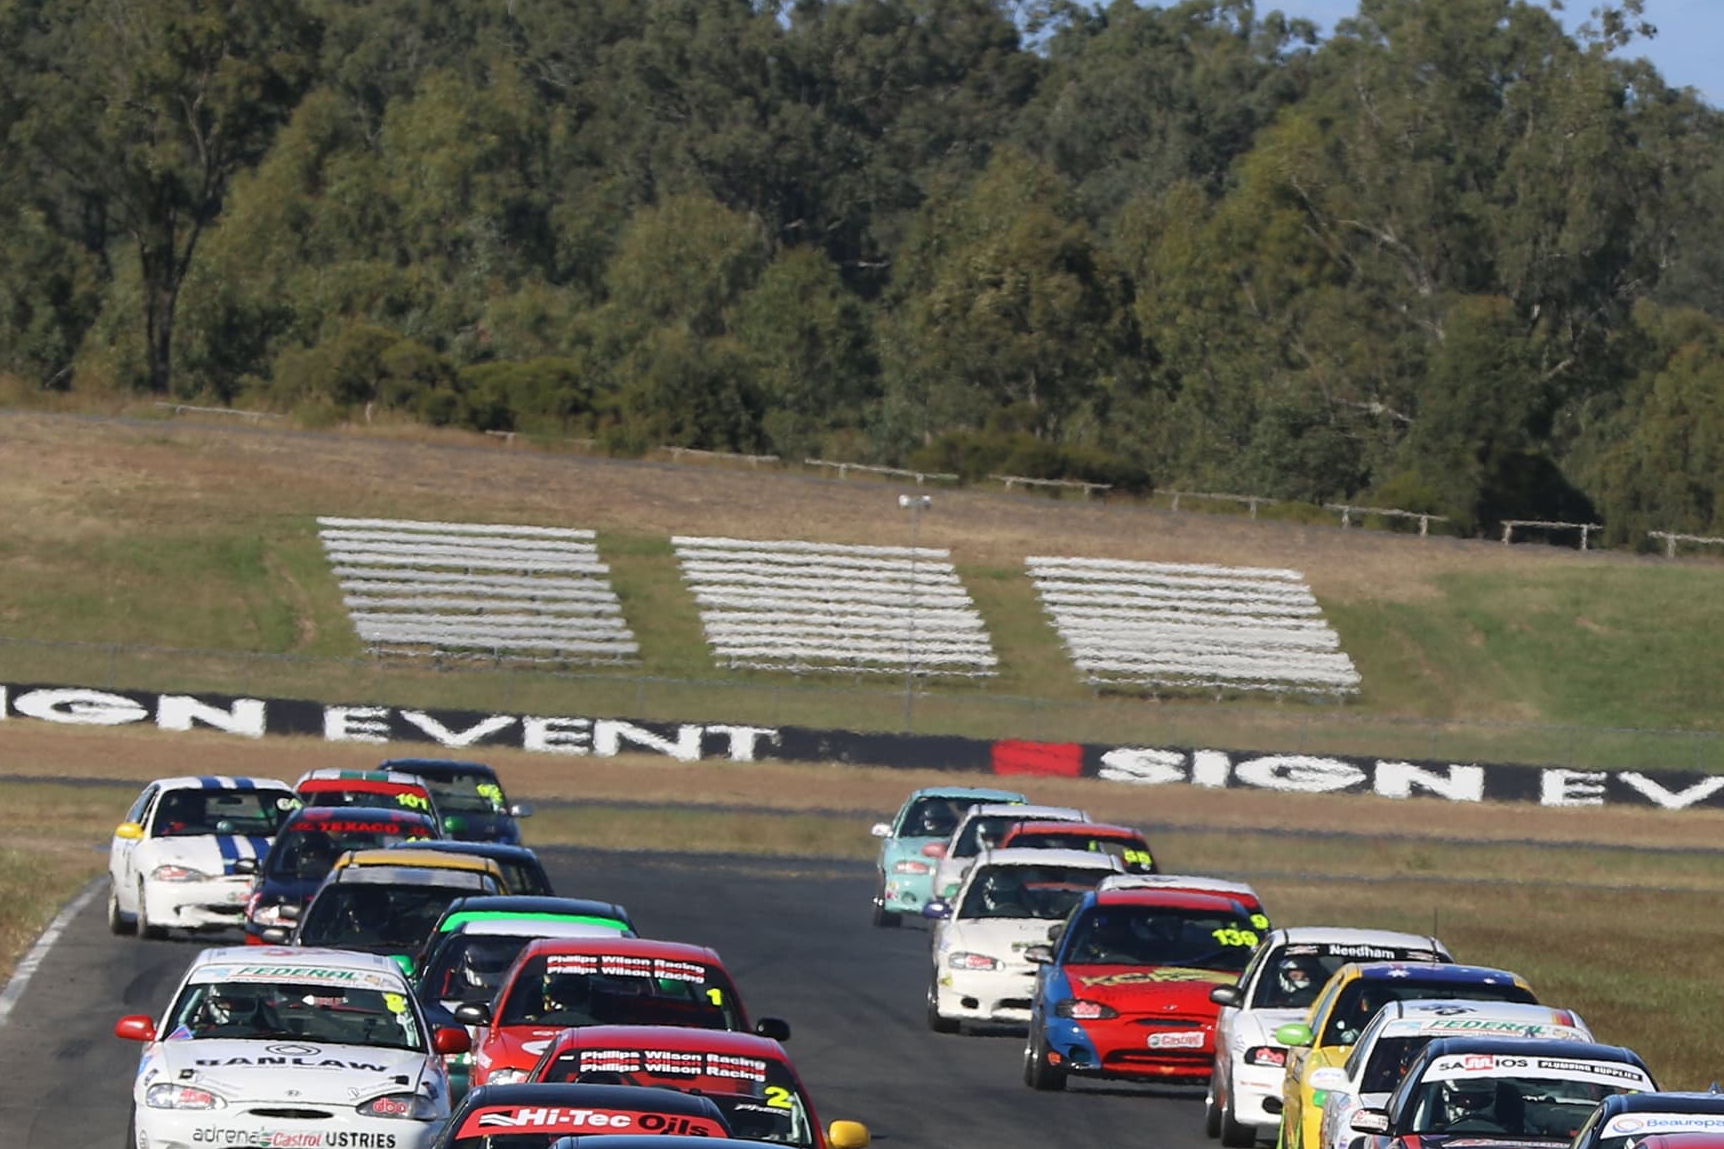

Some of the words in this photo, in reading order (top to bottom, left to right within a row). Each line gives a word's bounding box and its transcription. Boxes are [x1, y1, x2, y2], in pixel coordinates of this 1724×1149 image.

[0, 686, 266, 739] GN
[324, 705, 781, 761] EVENT
[1098, 748, 1485, 802] SIGN
[319, 821, 400, 836] TEXACO
[1328, 943, 1395, 960] Needham
[237, 966, 359, 982] FEDERAL
[601, 955, 651, 967] Wilson
[653, 958, 706, 975] Racing
[601, 966, 651, 978] Wilson
[653, 969, 705, 985] Racing
[706, 987, 723, 1007] 1
[1428, 1019, 1548, 1035] FEDERAL
[580, 1051, 641, 1061] Phillips
[644, 1050, 702, 1063] Wilson
[706, 1053, 767, 1070] Racing
[1438, 1054, 1529, 1072] SAMIOS
[1541, 1060, 1592, 1073] PLUMBING
[1594, 1066, 1642, 1082] SUPPLIES
[580, 1062, 641, 1073] Phillips
[644, 1063, 702, 1076] Wilson
[706, 1066, 767, 1083] Racing
[373, 1097, 408, 1114] dba
[765, 1085, 793, 1109] 2
[515, 1108, 631, 1129] Hi-Tec
[638, 1114, 709, 1137] Oils
[273, 1131, 322, 1148] Castrol
[326, 1132, 396, 1149] USTRIES
